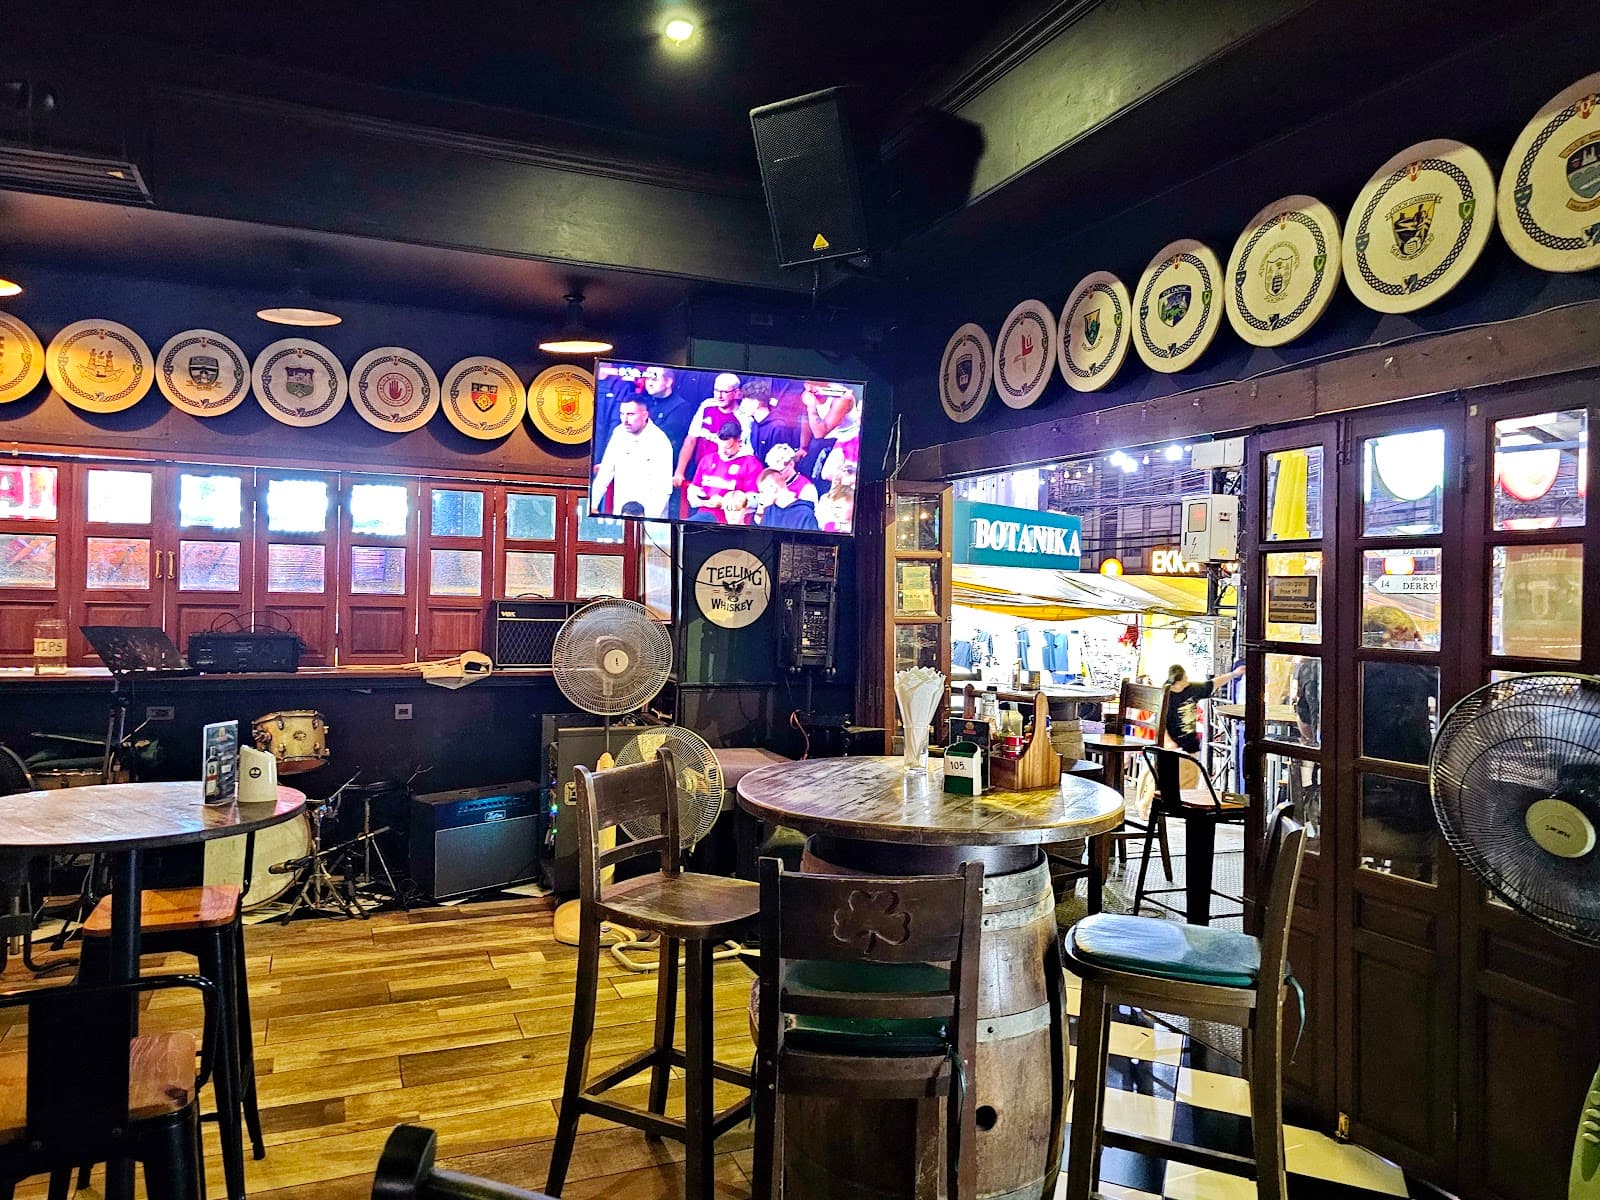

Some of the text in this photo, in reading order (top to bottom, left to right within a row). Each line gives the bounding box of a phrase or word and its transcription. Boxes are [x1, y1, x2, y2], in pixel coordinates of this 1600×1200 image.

[969, 518, 1081, 557] BOTANIKA
[706, 565, 762, 586] TEELING
[1402, 582, 1435, 590] DERRY
[711, 598, 754, 612] WHISKEY
[36, 641, 64, 652] TIPS
